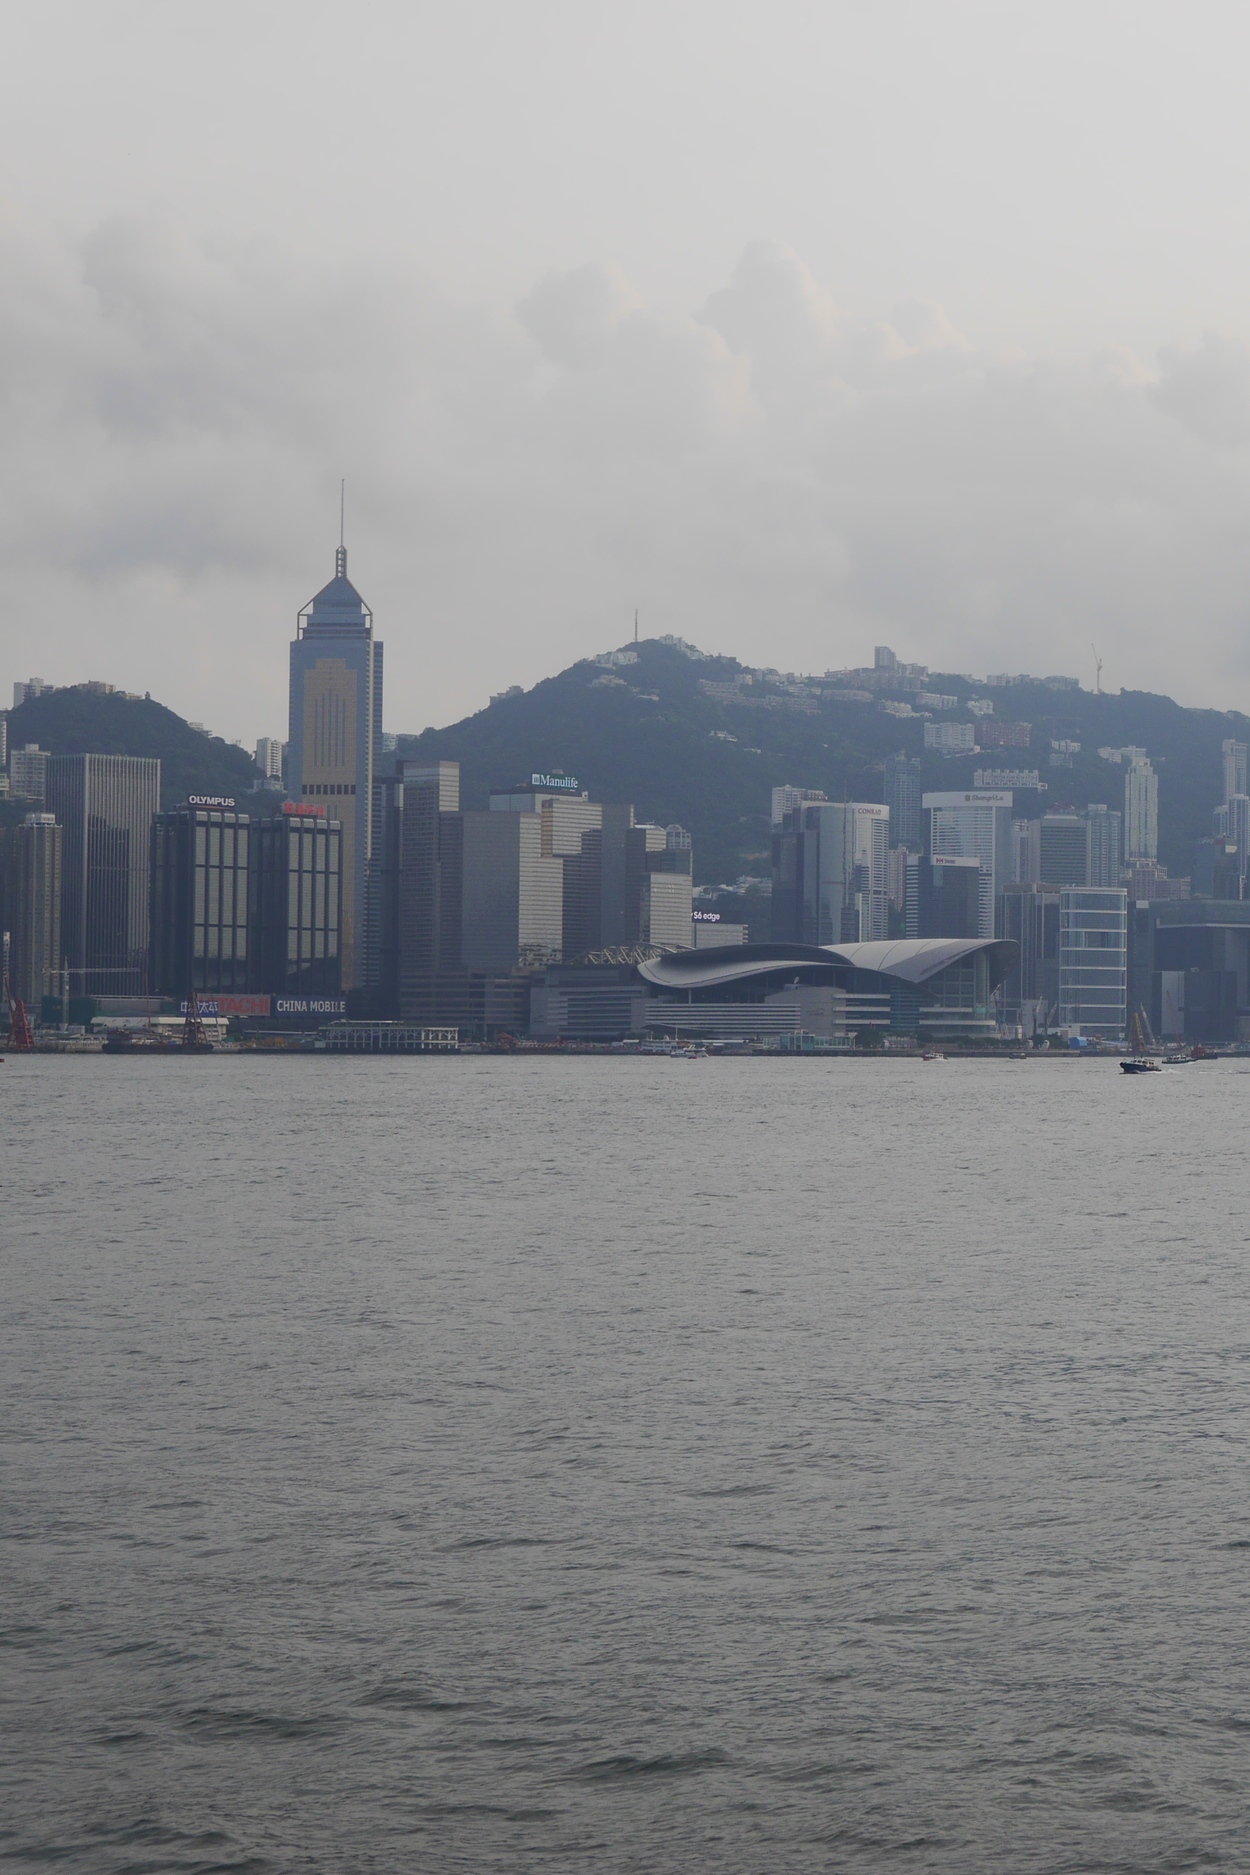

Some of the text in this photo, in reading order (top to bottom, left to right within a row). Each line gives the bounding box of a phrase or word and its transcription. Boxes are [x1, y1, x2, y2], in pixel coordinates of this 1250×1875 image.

[540, 775, 579, 788] Manulife
[189, 795, 235, 807] OLYMPUS
[693, 911, 721, 922] S6 edge
[199, 997, 270, 1014] TACHI
[277, 1000, 346, 1012] CHINA MOBILE
